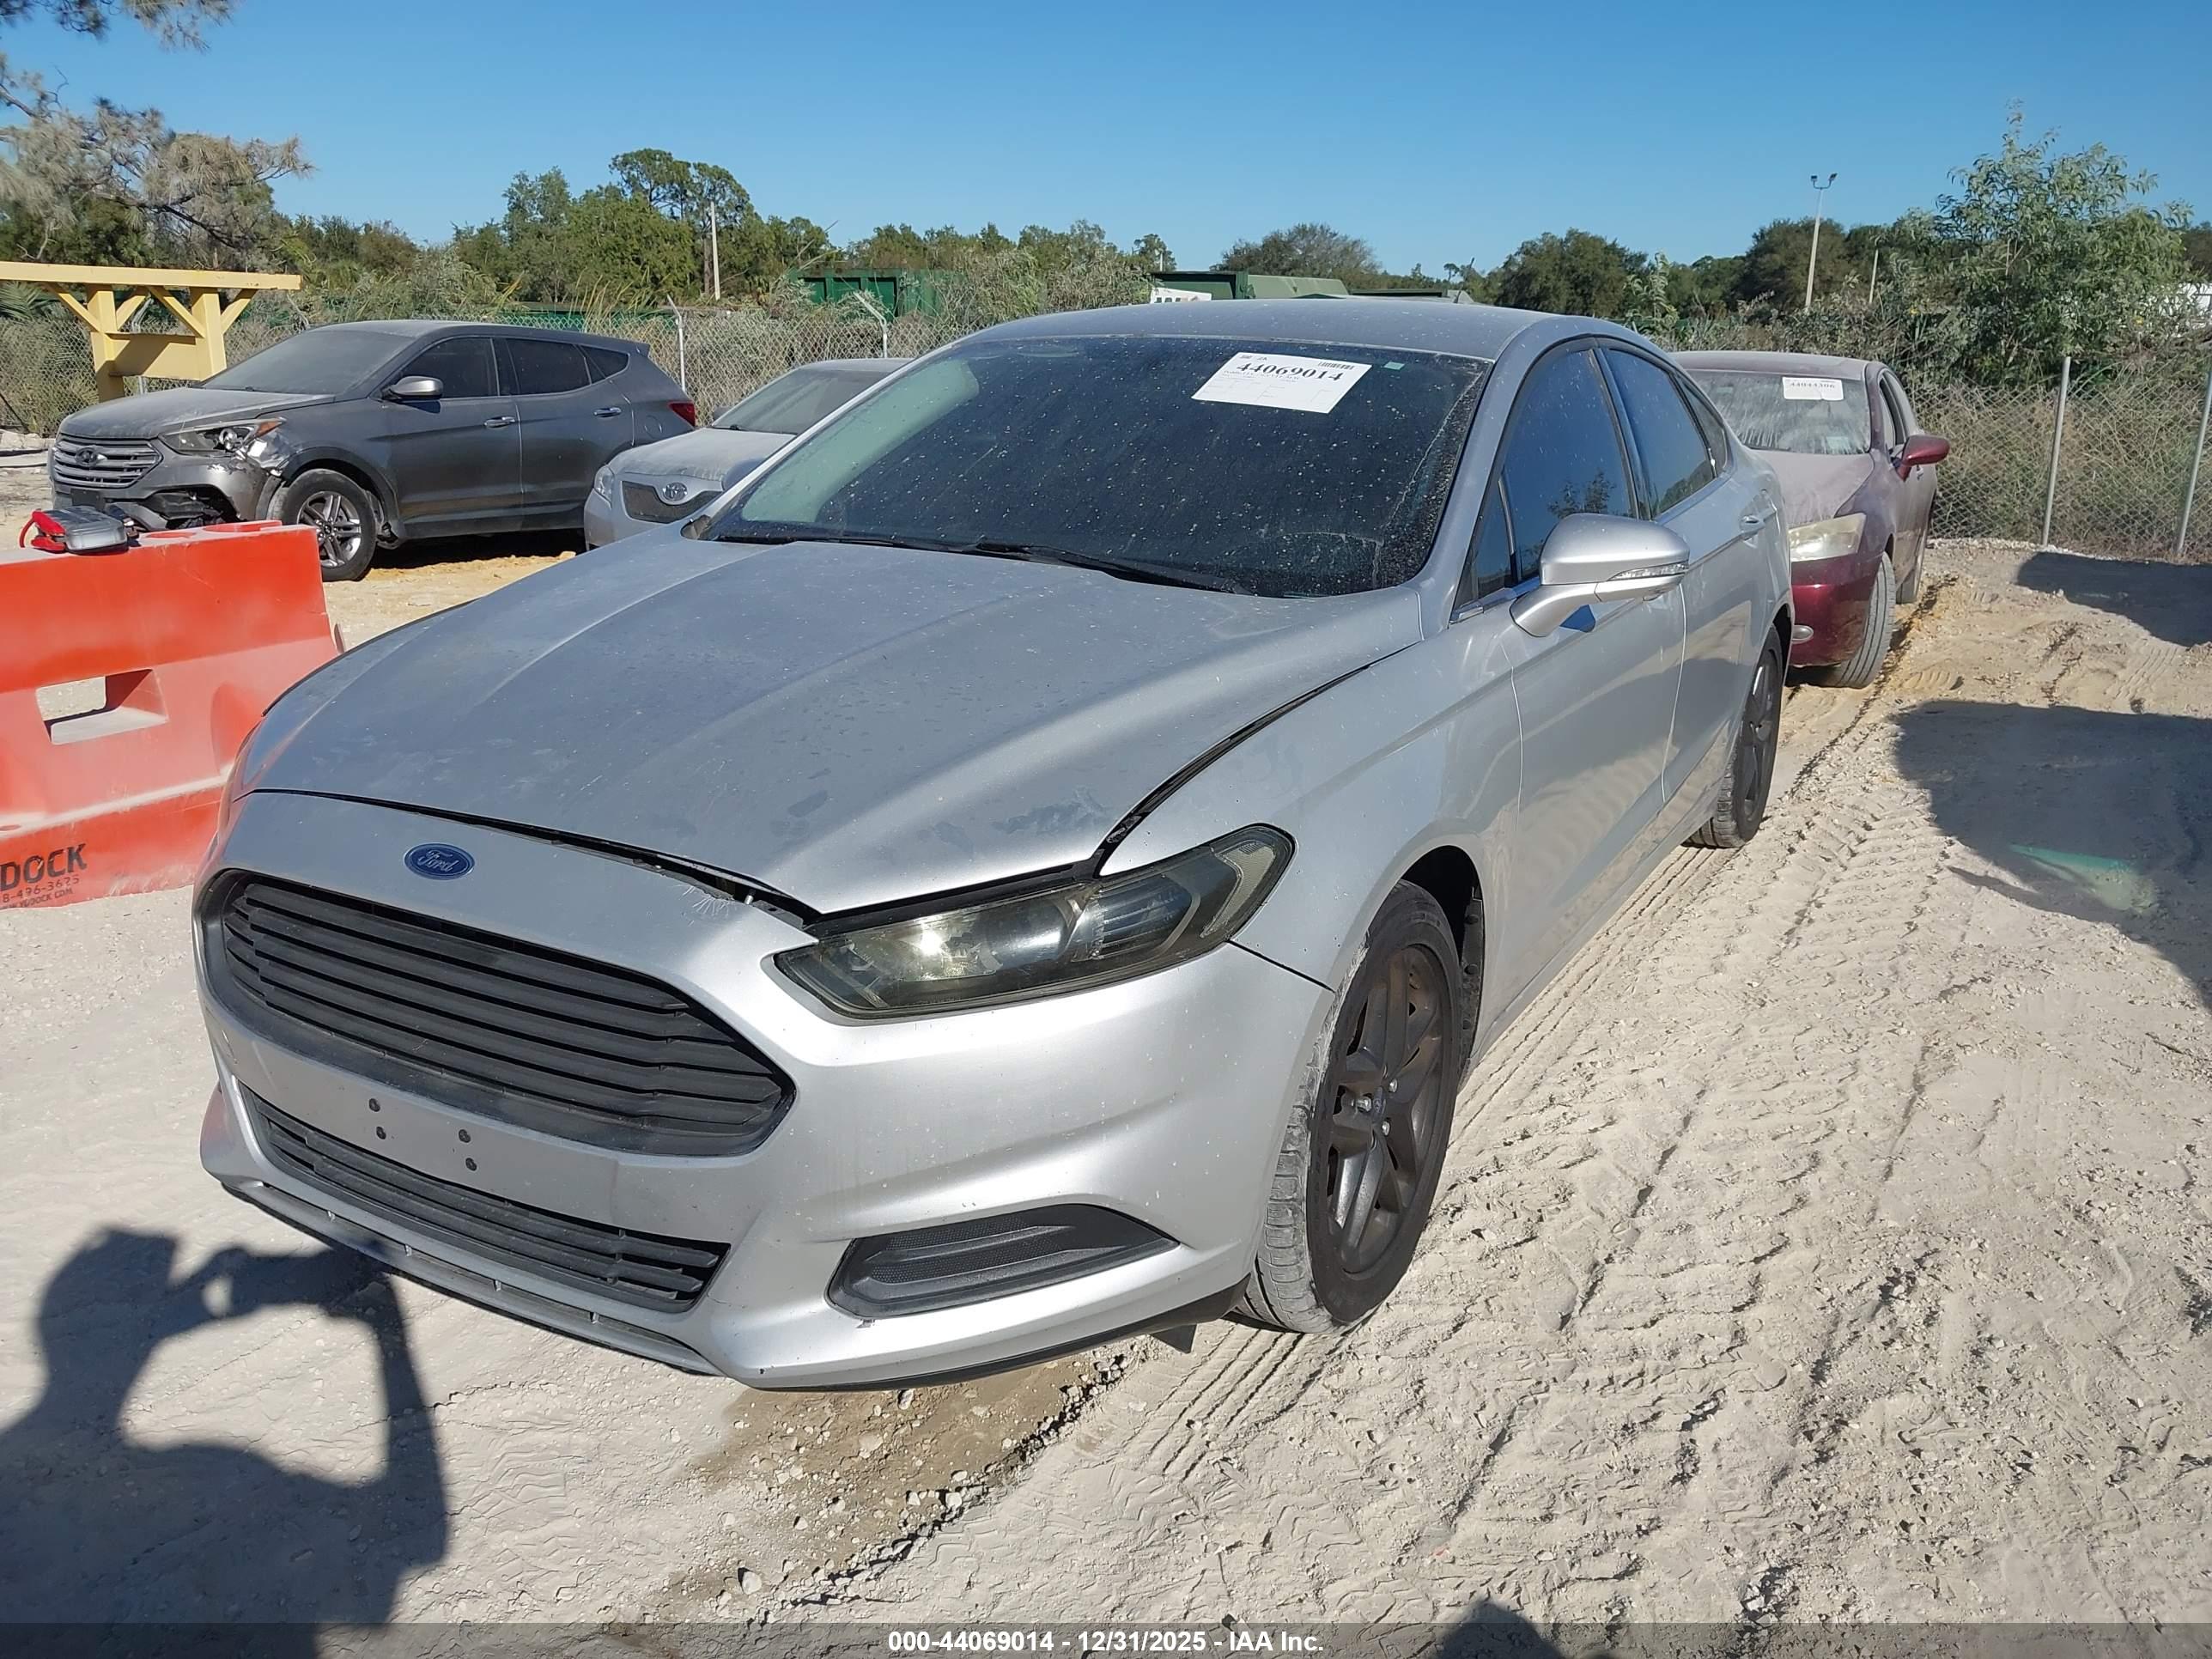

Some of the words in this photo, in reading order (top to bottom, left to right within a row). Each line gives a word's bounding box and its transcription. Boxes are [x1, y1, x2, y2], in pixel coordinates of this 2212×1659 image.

[1237, 362, 1344, 381] 44069014
[0, 843, 88, 891] DOCK
[417, 850, 459, 872] Ford
